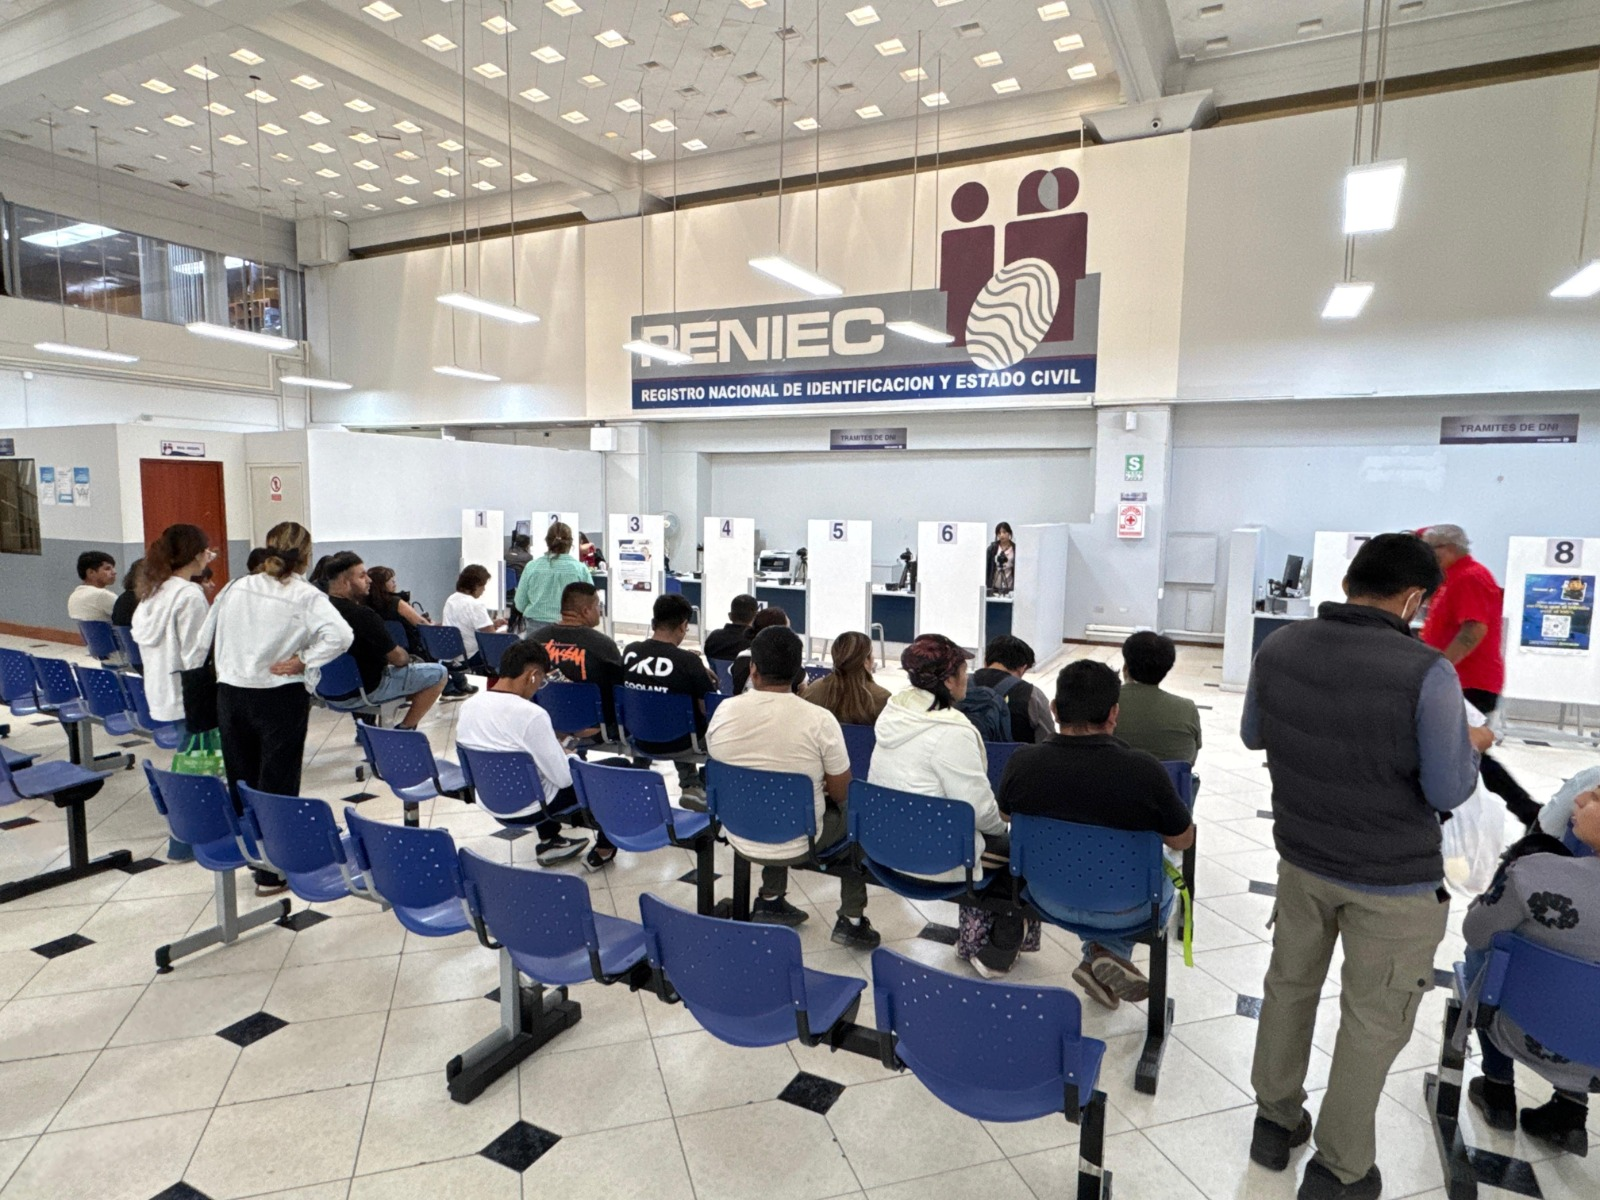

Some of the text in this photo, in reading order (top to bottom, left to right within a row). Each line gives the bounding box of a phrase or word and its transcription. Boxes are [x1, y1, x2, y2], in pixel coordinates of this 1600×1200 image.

[641, 307, 885, 367] RENIEC
[641, 368, 1081, 402] REGISTRO NACIONAL DE IDENTIFICACION Y ESTADO CIVIL
[1460, 423, 1559, 433] TRAMITES DE DNI
[840, 434, 873, 442] TRAMITES
[1128, 456, 1141, 471] S
[477, 511, 484, 526] 1
[630, 516, 640, 532] 3
[722, 519, 731, 536] 4
[832, 522, 844, 539] 5
[941, 524, 953, 542] 6
[1554, 541, 1574, 564] 8
